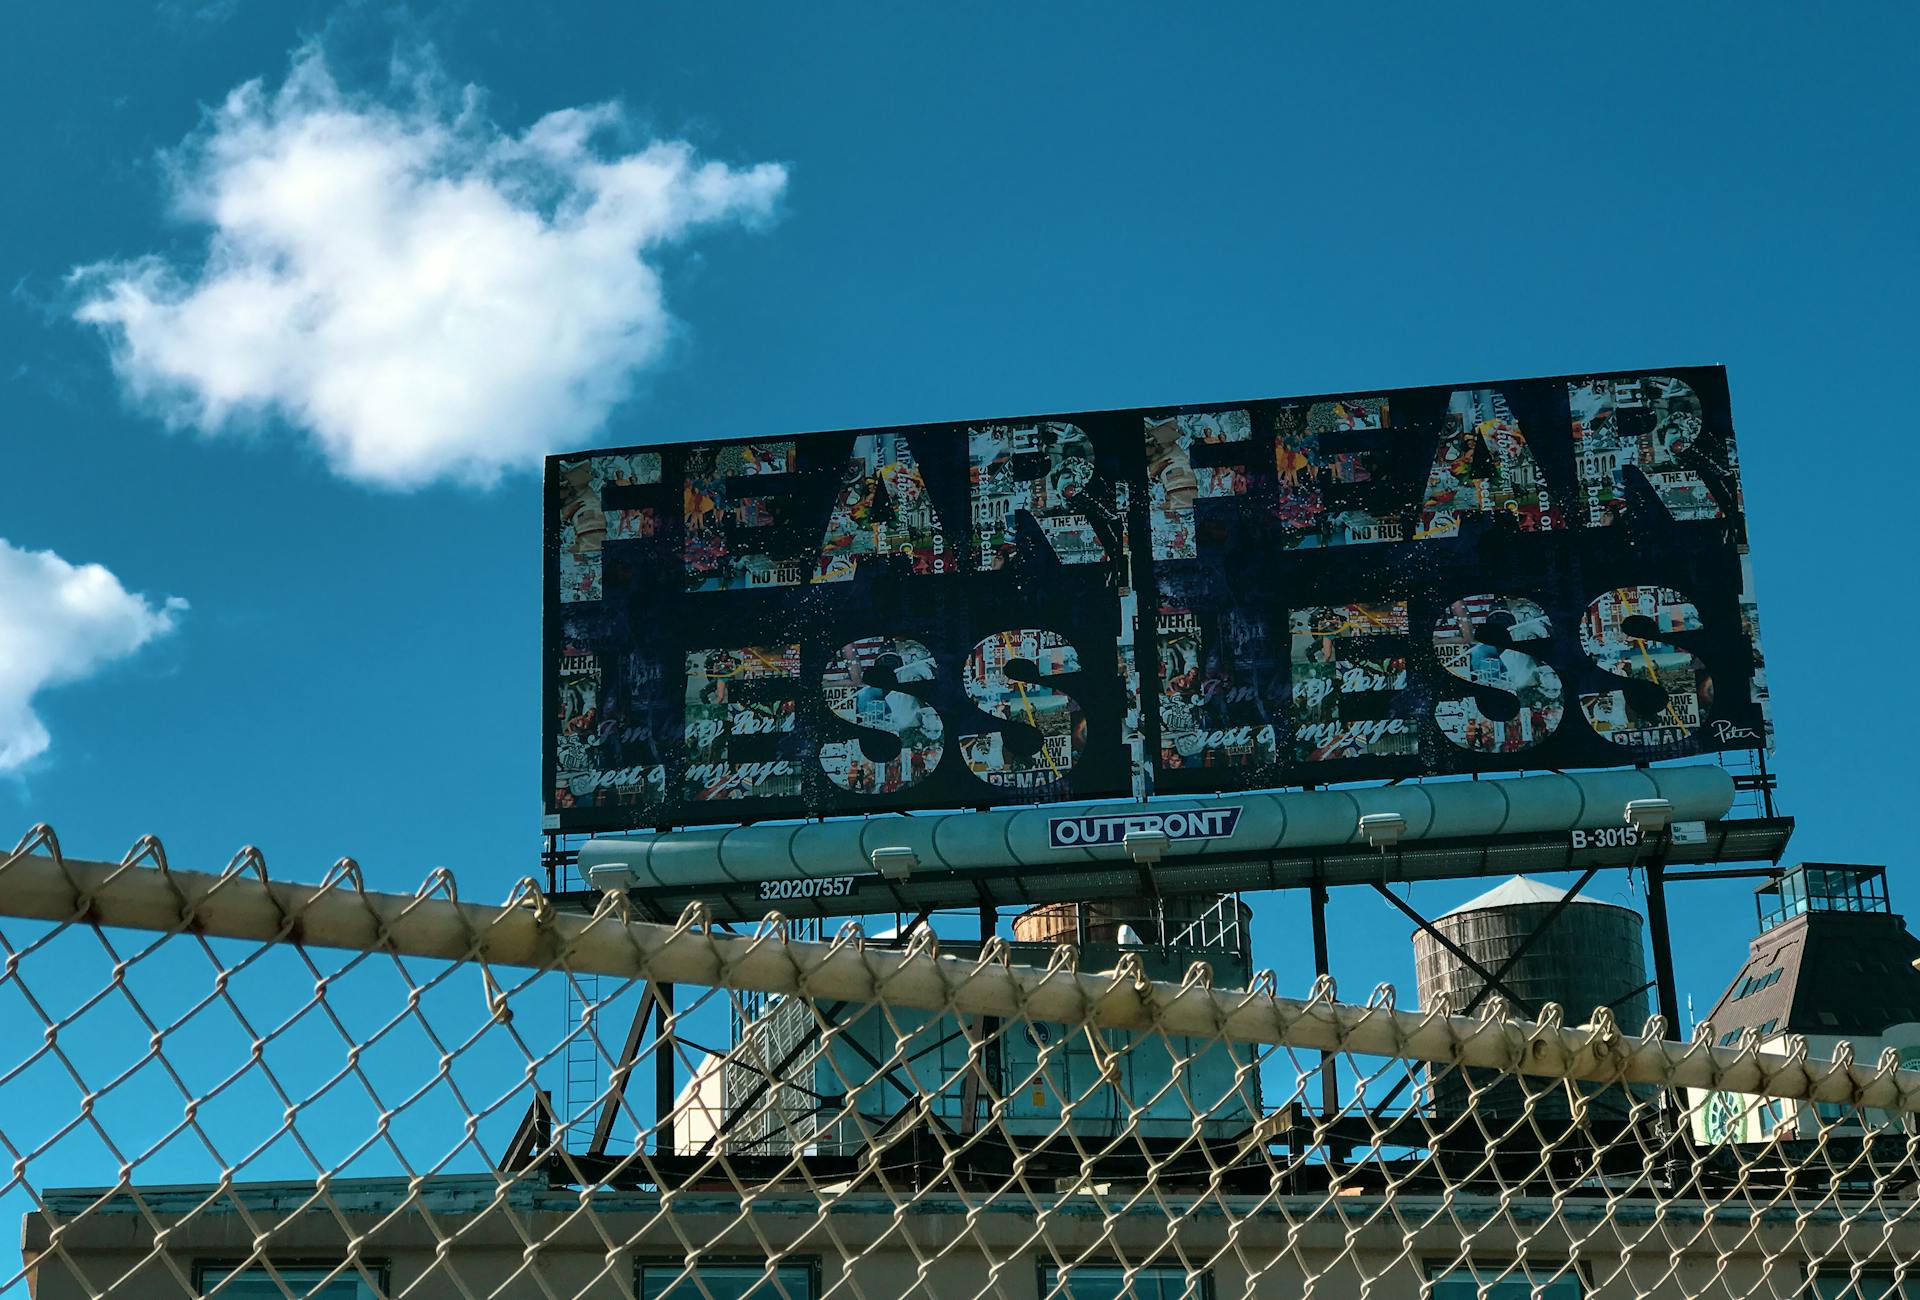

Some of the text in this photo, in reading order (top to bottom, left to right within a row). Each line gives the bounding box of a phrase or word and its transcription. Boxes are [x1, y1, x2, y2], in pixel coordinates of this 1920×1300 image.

[1143, 376, 1722, 560] FEAR
[1661, 472, 1682, 484] THE
[559, 421, 1112, 604] FEAR
[1052, 517, 1071, 528] THE
[1352, 526, 1371, 540] NO
[752, 570, 771, 584] NO
[1157, 586, 1713, 768] LESS
[555, 628, 1087, 808] LESS
[1572, 828, 1638, 849] B-3015
[759, 875, 855, 901] 320207557
